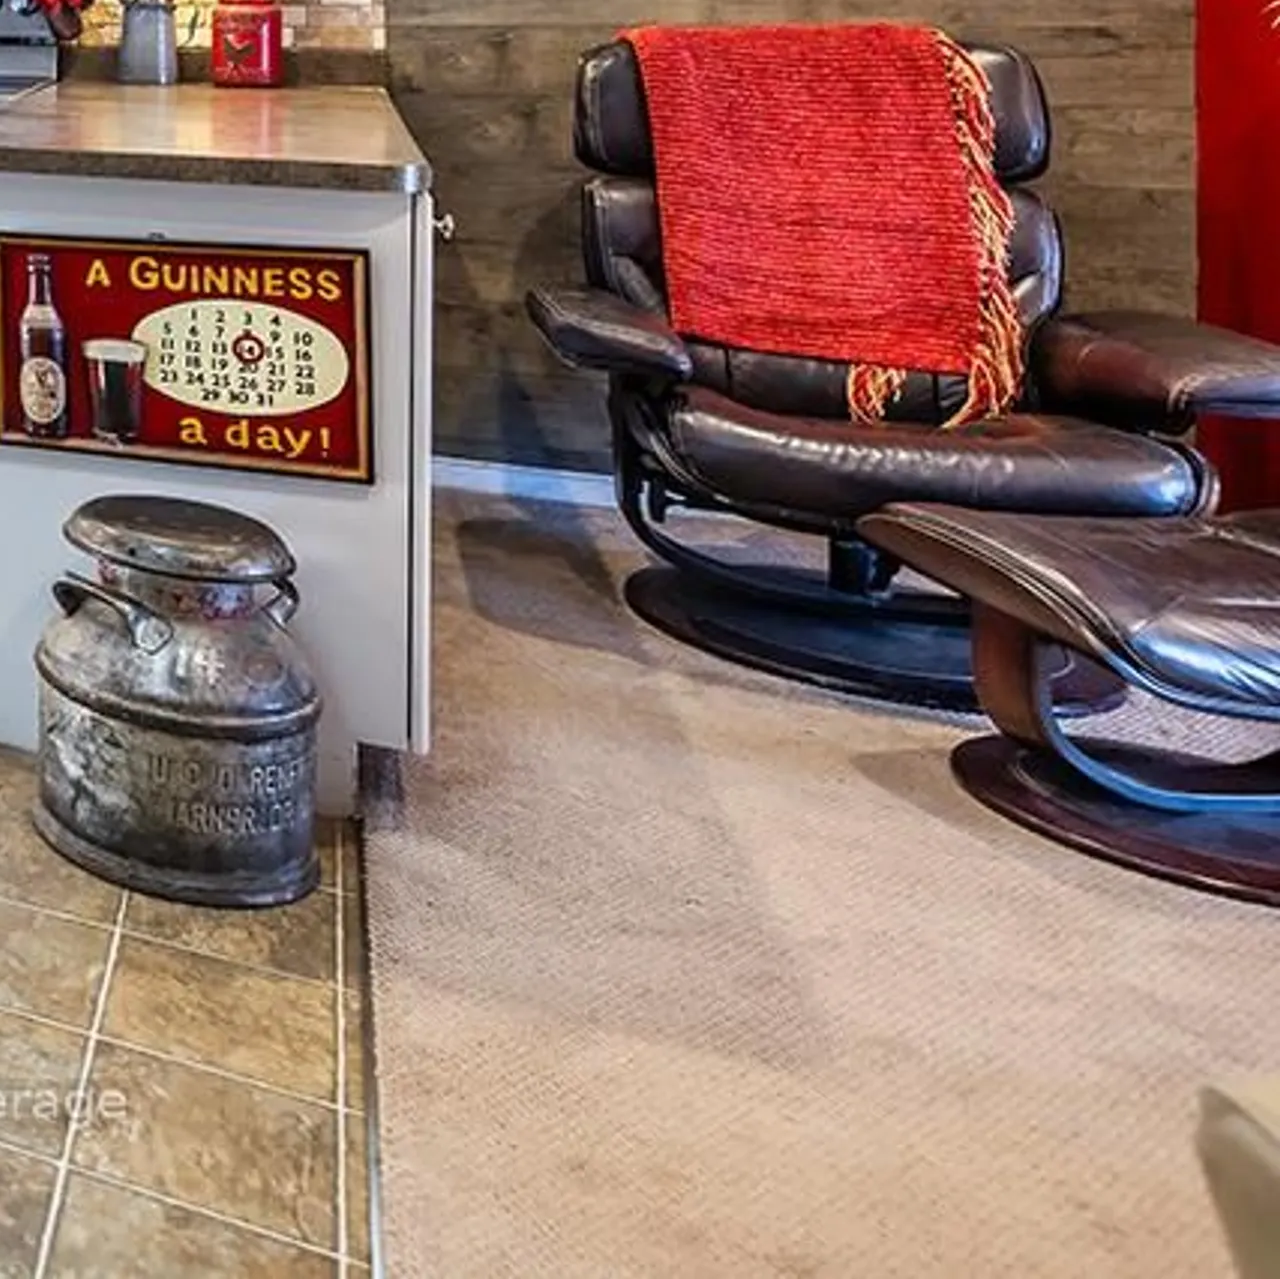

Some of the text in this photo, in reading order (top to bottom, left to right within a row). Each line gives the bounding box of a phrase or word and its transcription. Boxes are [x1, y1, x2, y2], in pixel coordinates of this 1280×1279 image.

[85, 255, 342, 301] A GUINNESS
[179, 418, 331, 459] a day!
